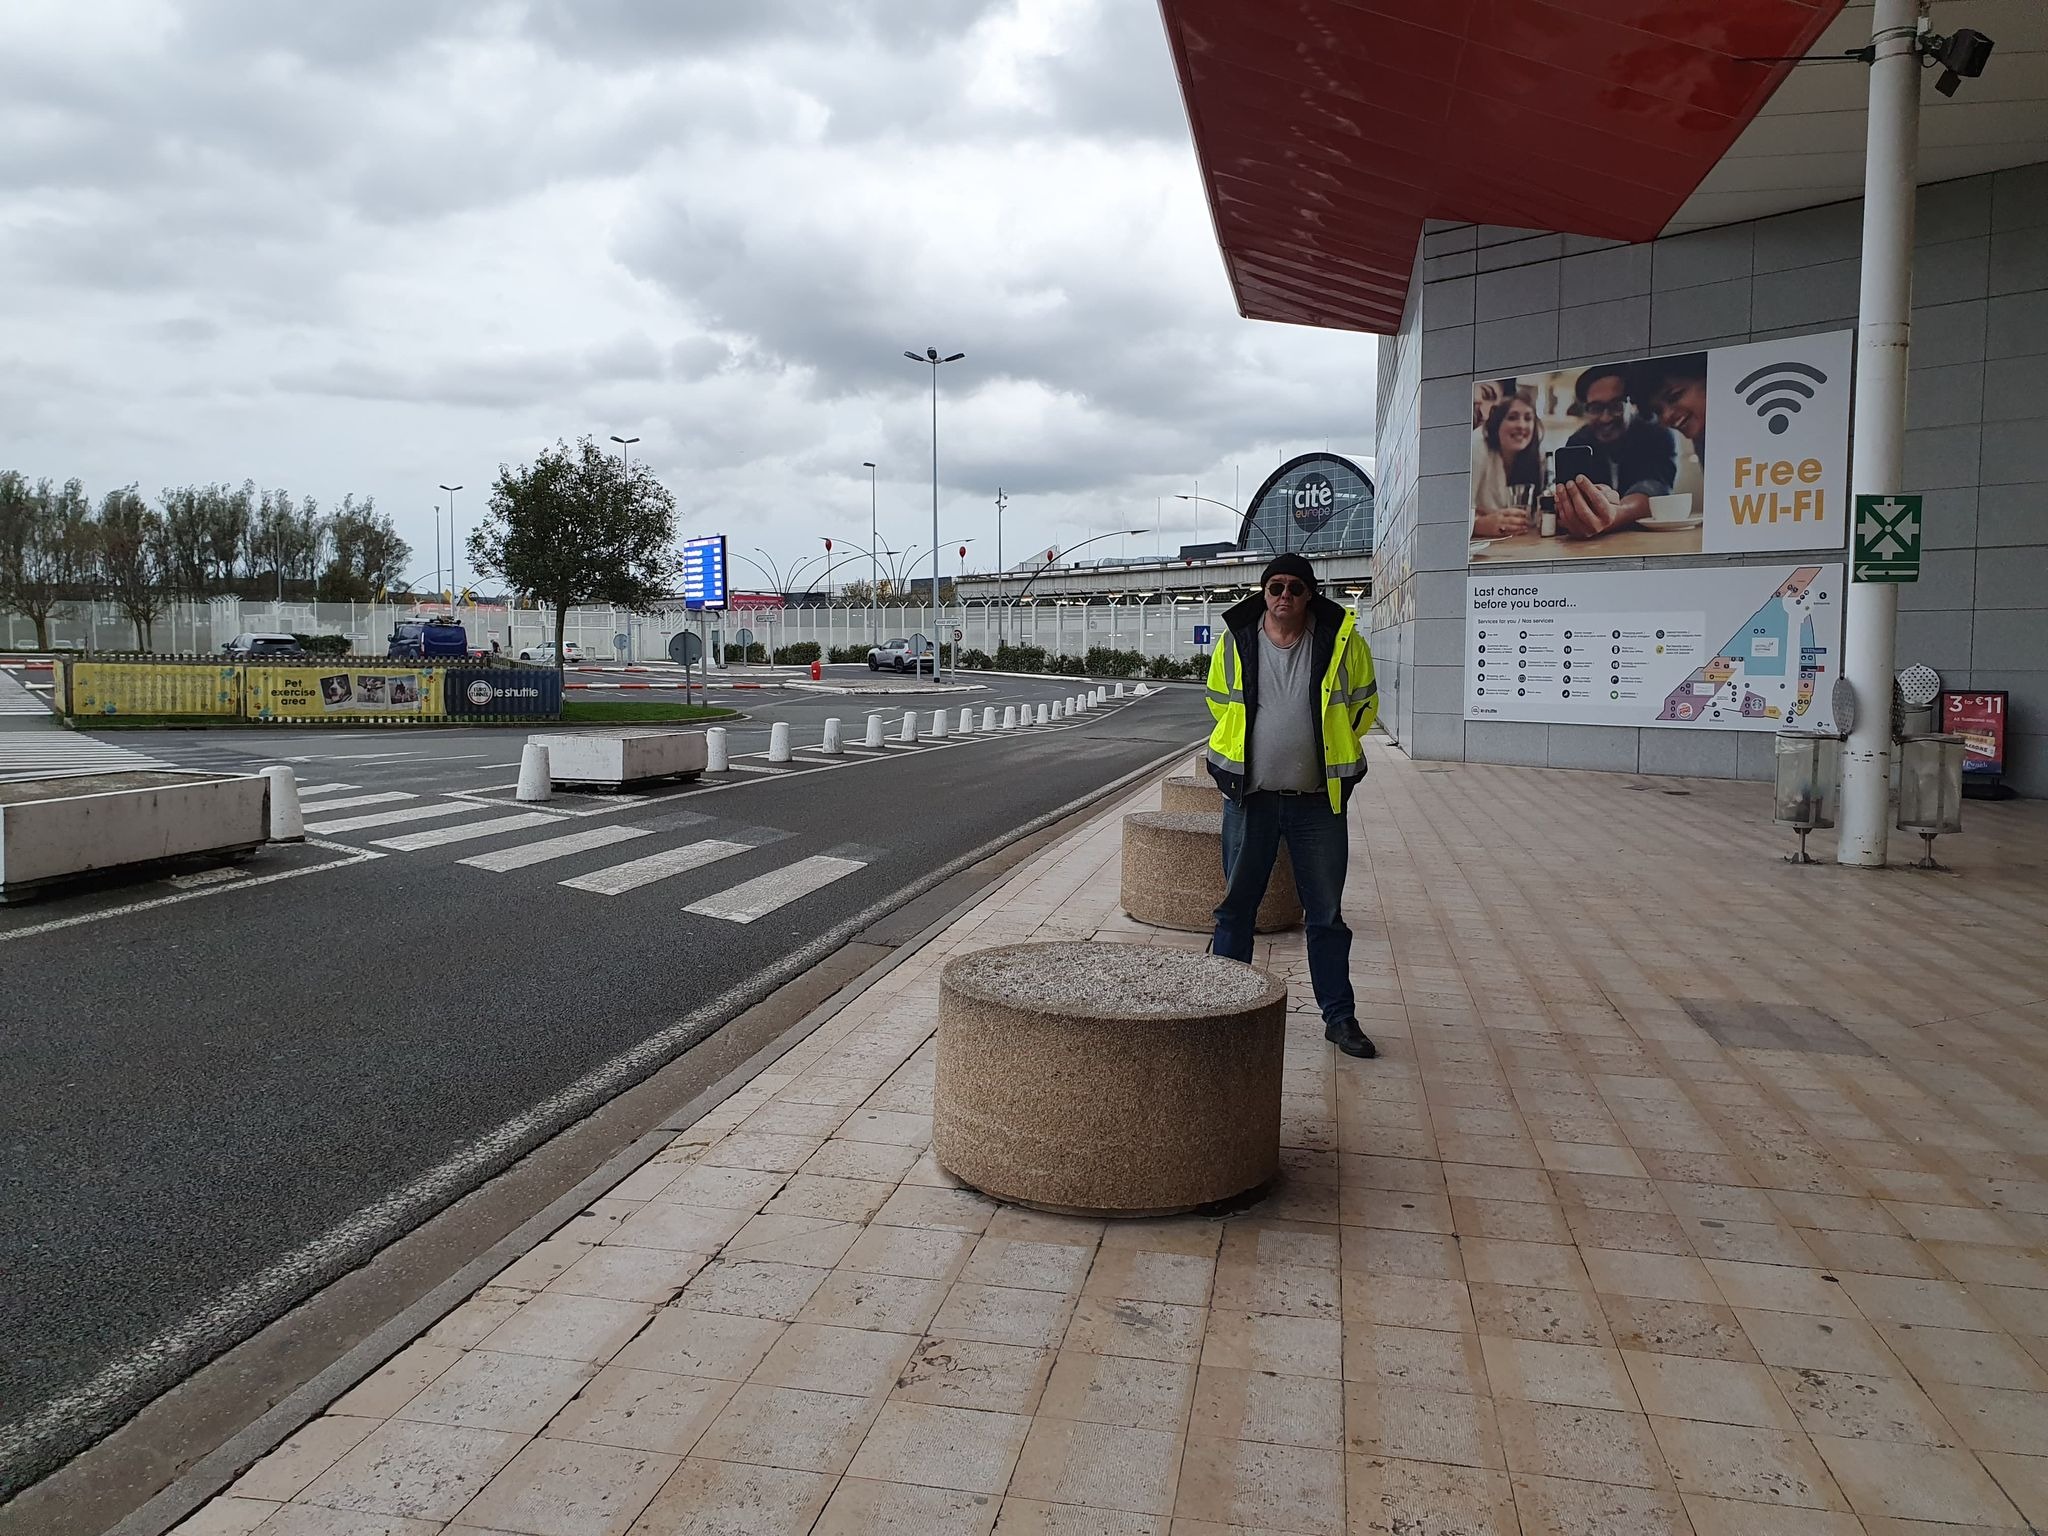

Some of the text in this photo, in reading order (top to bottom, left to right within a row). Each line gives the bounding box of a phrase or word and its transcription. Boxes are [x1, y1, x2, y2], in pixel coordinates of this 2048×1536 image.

[1735, 457, 1823, 488] Free
[1295, 481, 1332, 509] cité
[1295, 507, 1331, 520] europe
[1729, 489, 1824, 525] WI-FI
[1474, 586, 1538, 597] Last chance
[1474, 597, 1577, 610] before you board...
[285, 679, 302, 688] Pet
[271, 688, 316, 697] exercise
[493, 687, 539, 697] le shuttle
[1948, 695, 1963, 712] 3
[1975, 696, 2002, 713] €11
